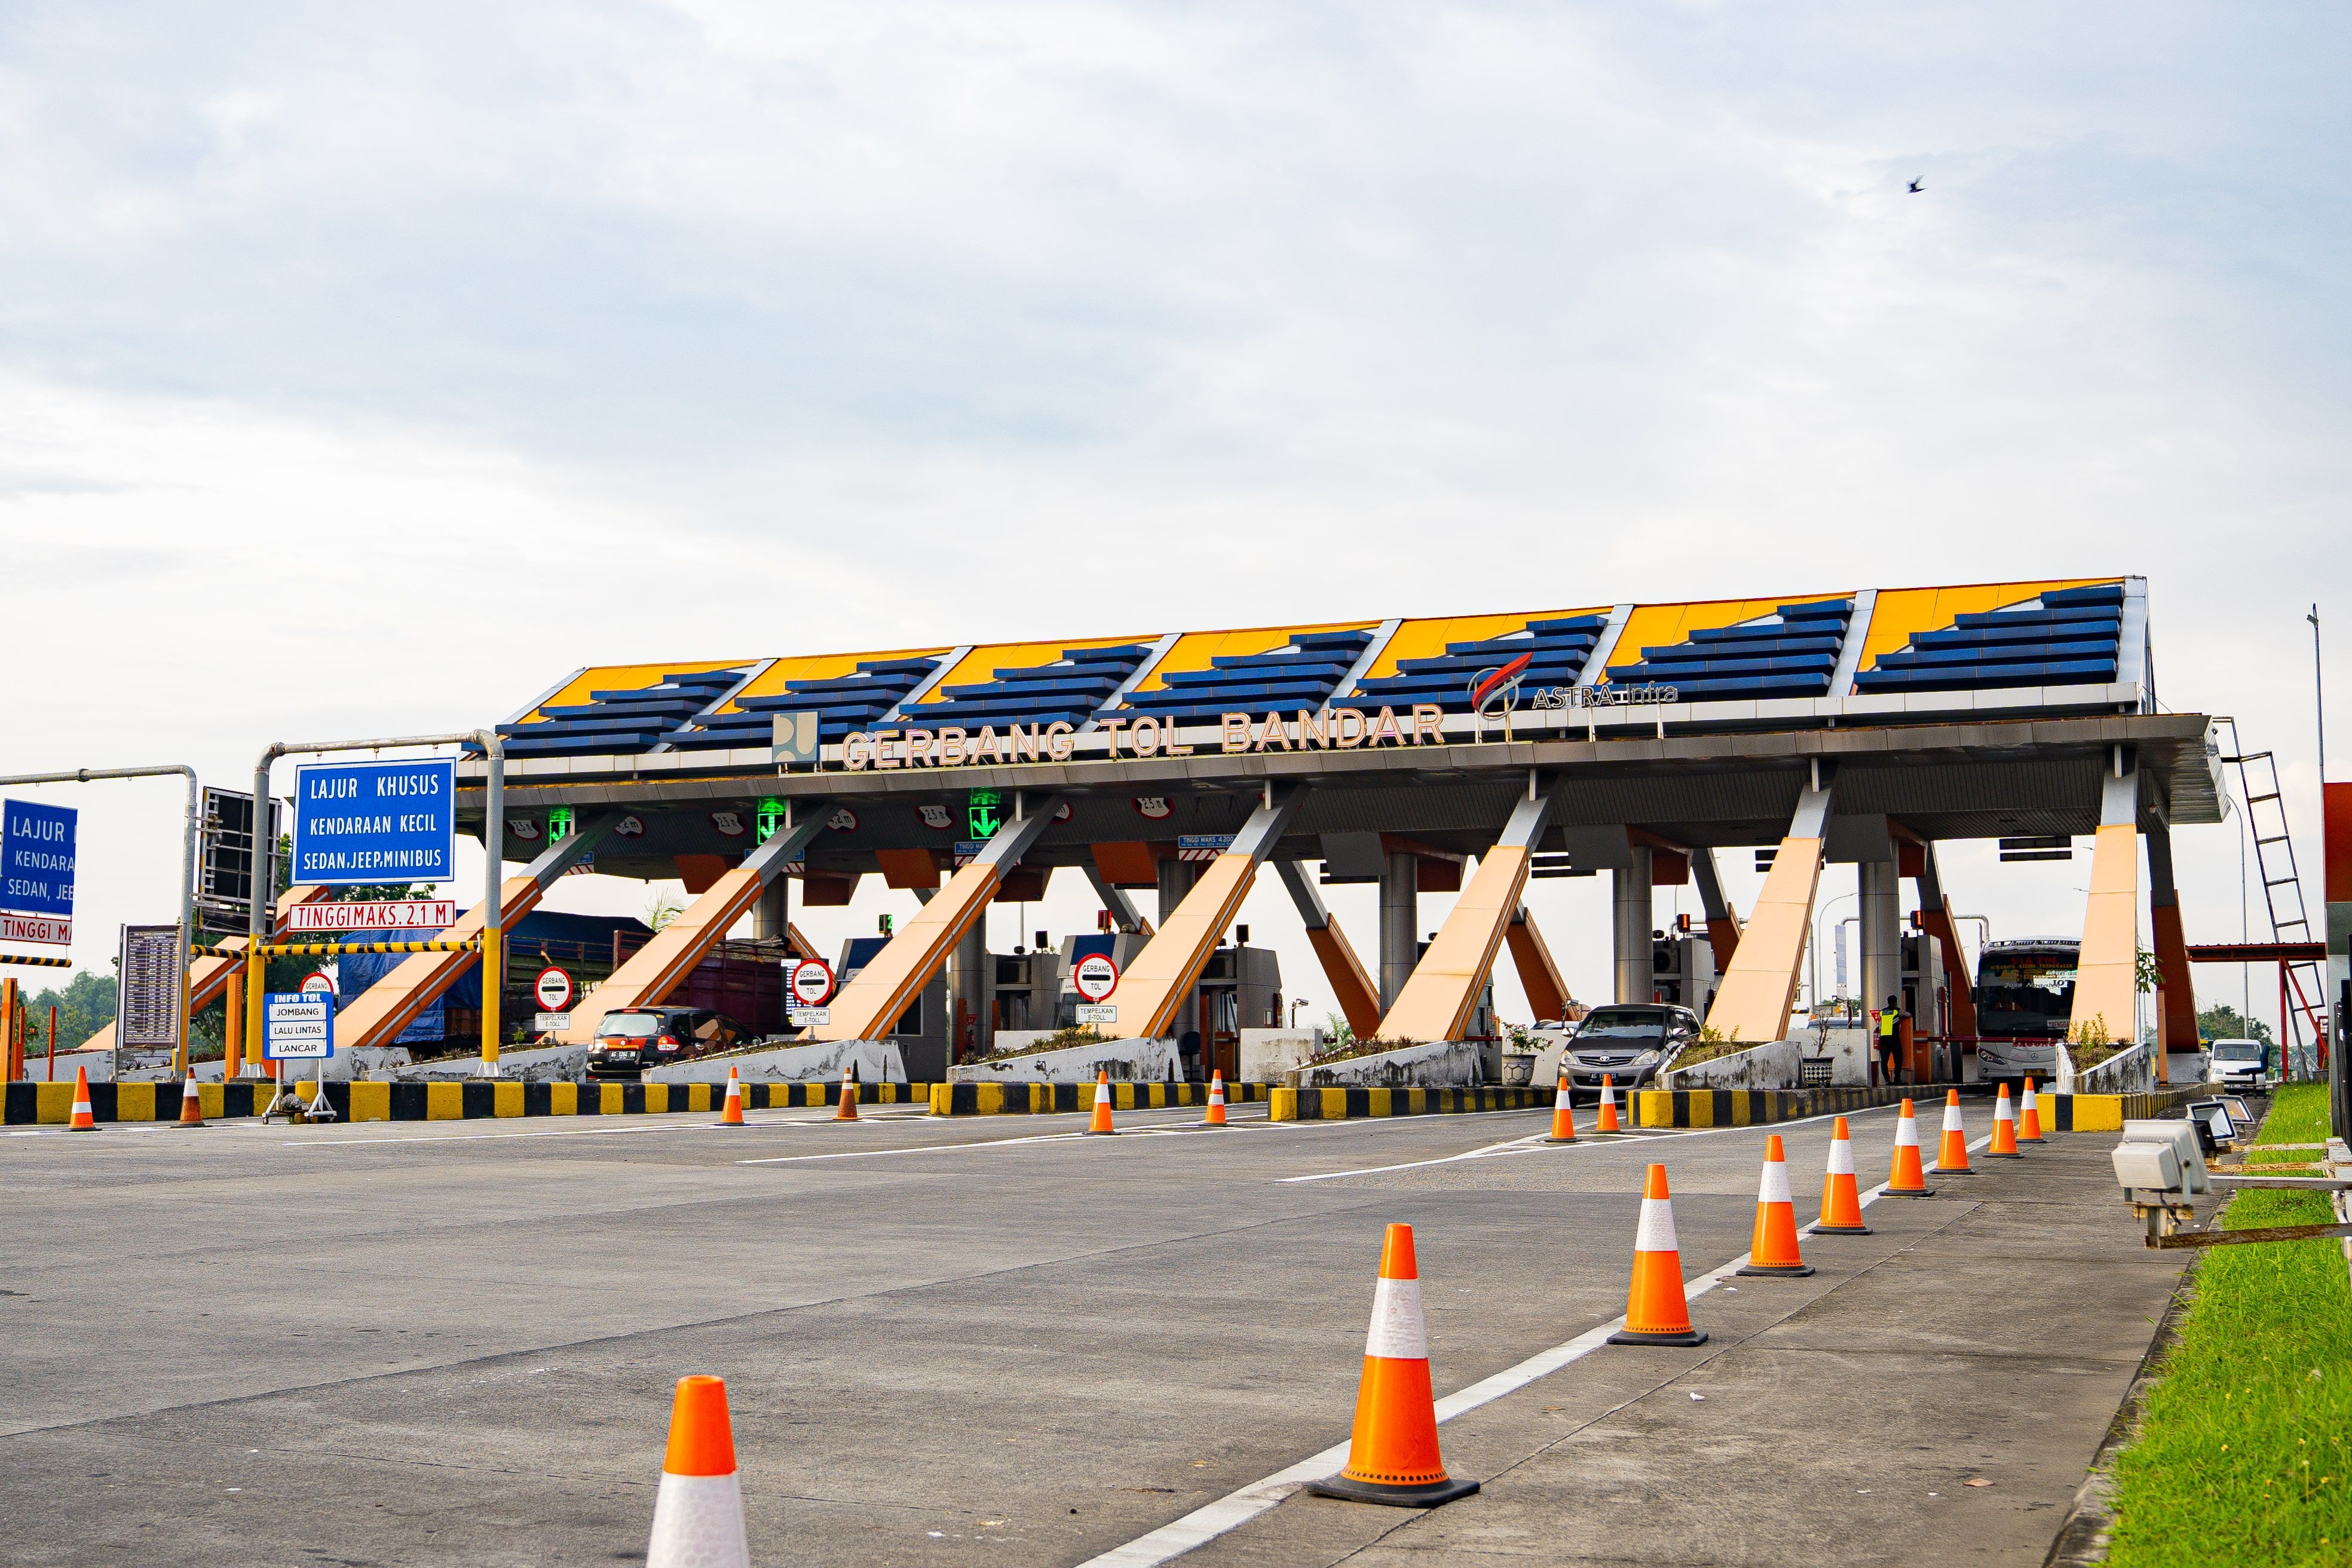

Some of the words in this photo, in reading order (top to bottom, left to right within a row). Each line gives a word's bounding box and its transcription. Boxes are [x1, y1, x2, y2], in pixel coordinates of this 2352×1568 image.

[1532, 685, 1616, 709] ASTRA
[1626, 680, 1678, 705] Infra
[843, 721, 1074, 770] GERBANG
[1100, 716, 1194, 757] TOL
[1222, 704, 1445, 752] BANDAR
[311, 778, 357, 800] LAJUR
[377, 774, 439, 797] KHUSUS
[13, 816, 65, 842] LAJUR
[310, 816, 391, 835] KENDARAAN
[400, 814, 437, 832] KECIL
[15, 850, 75, 872] KENDARA
[8, 878, 50, 901] SEDAN,
[436, 904, 446, 924] M
[887, 915, 893, 929] 2
[3, 920, 51, 939] TINGGI
[274, 994, 300, 1003] INFO
[302, 993, 322, 1003] TOL
[277, 1008, 319, 1016] JOMBANG
